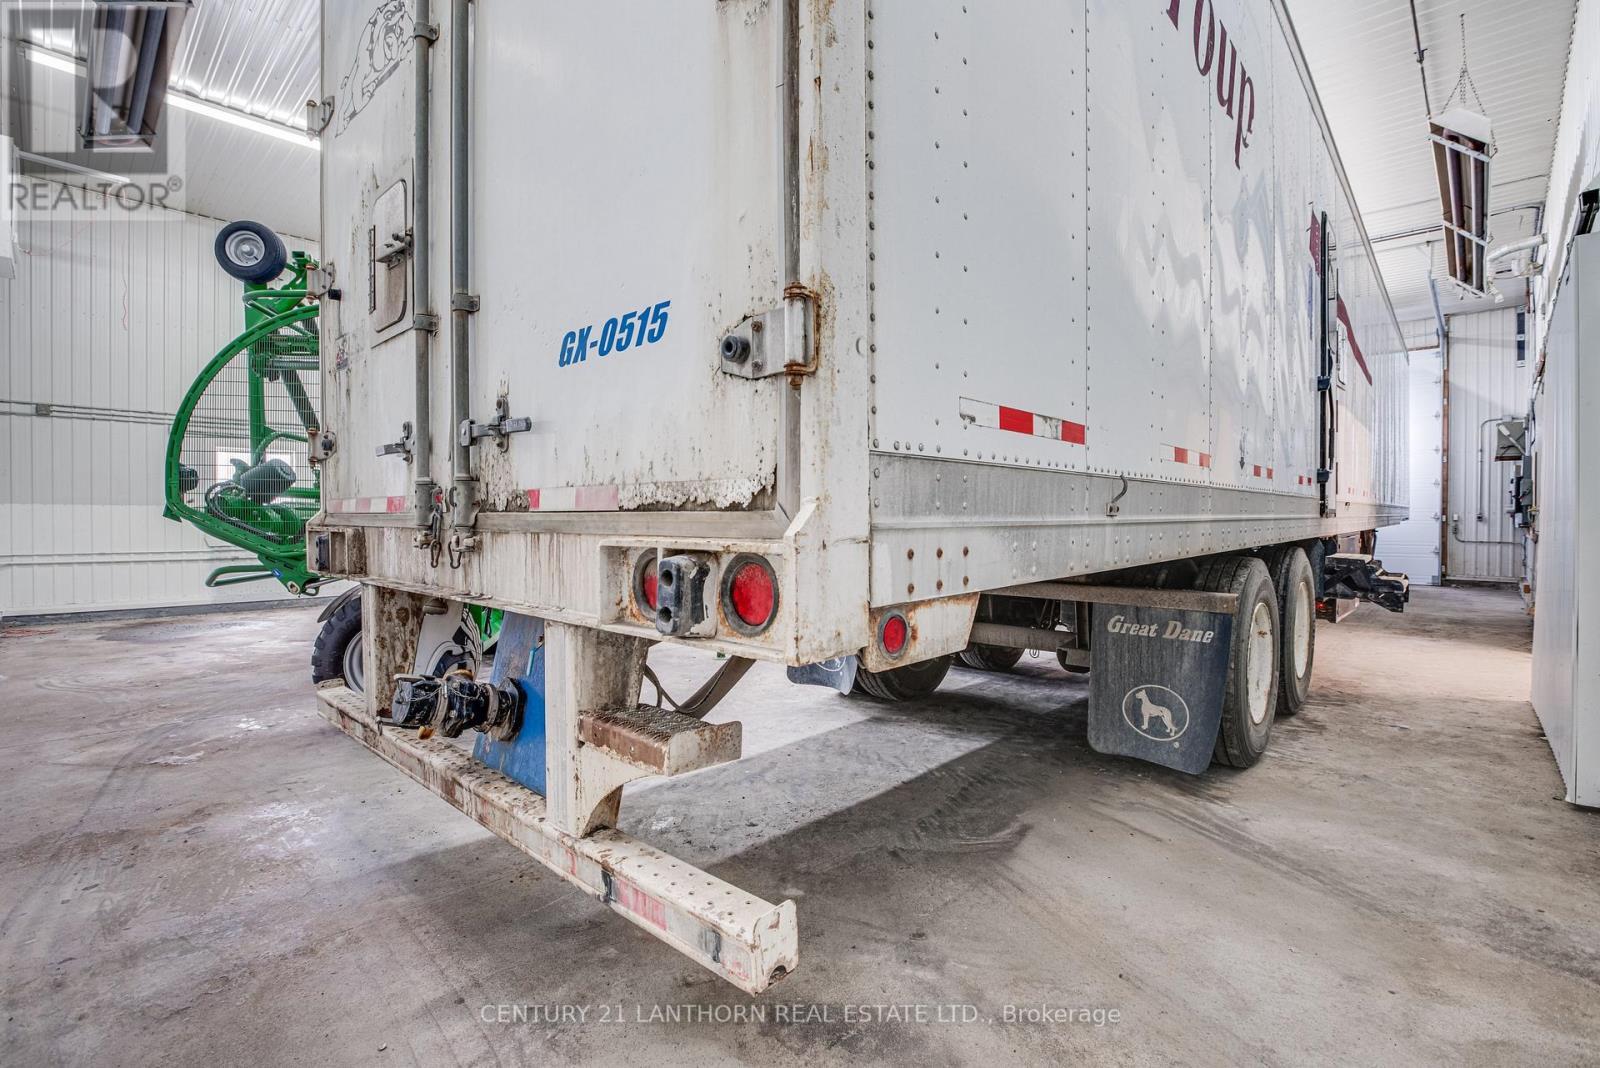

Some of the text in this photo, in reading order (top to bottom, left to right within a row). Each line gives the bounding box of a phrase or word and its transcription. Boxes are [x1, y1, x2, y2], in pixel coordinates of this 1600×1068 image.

[558, 300, 671, 368] GX-0515
[1107, 615, 1214, 643] Great Dane
